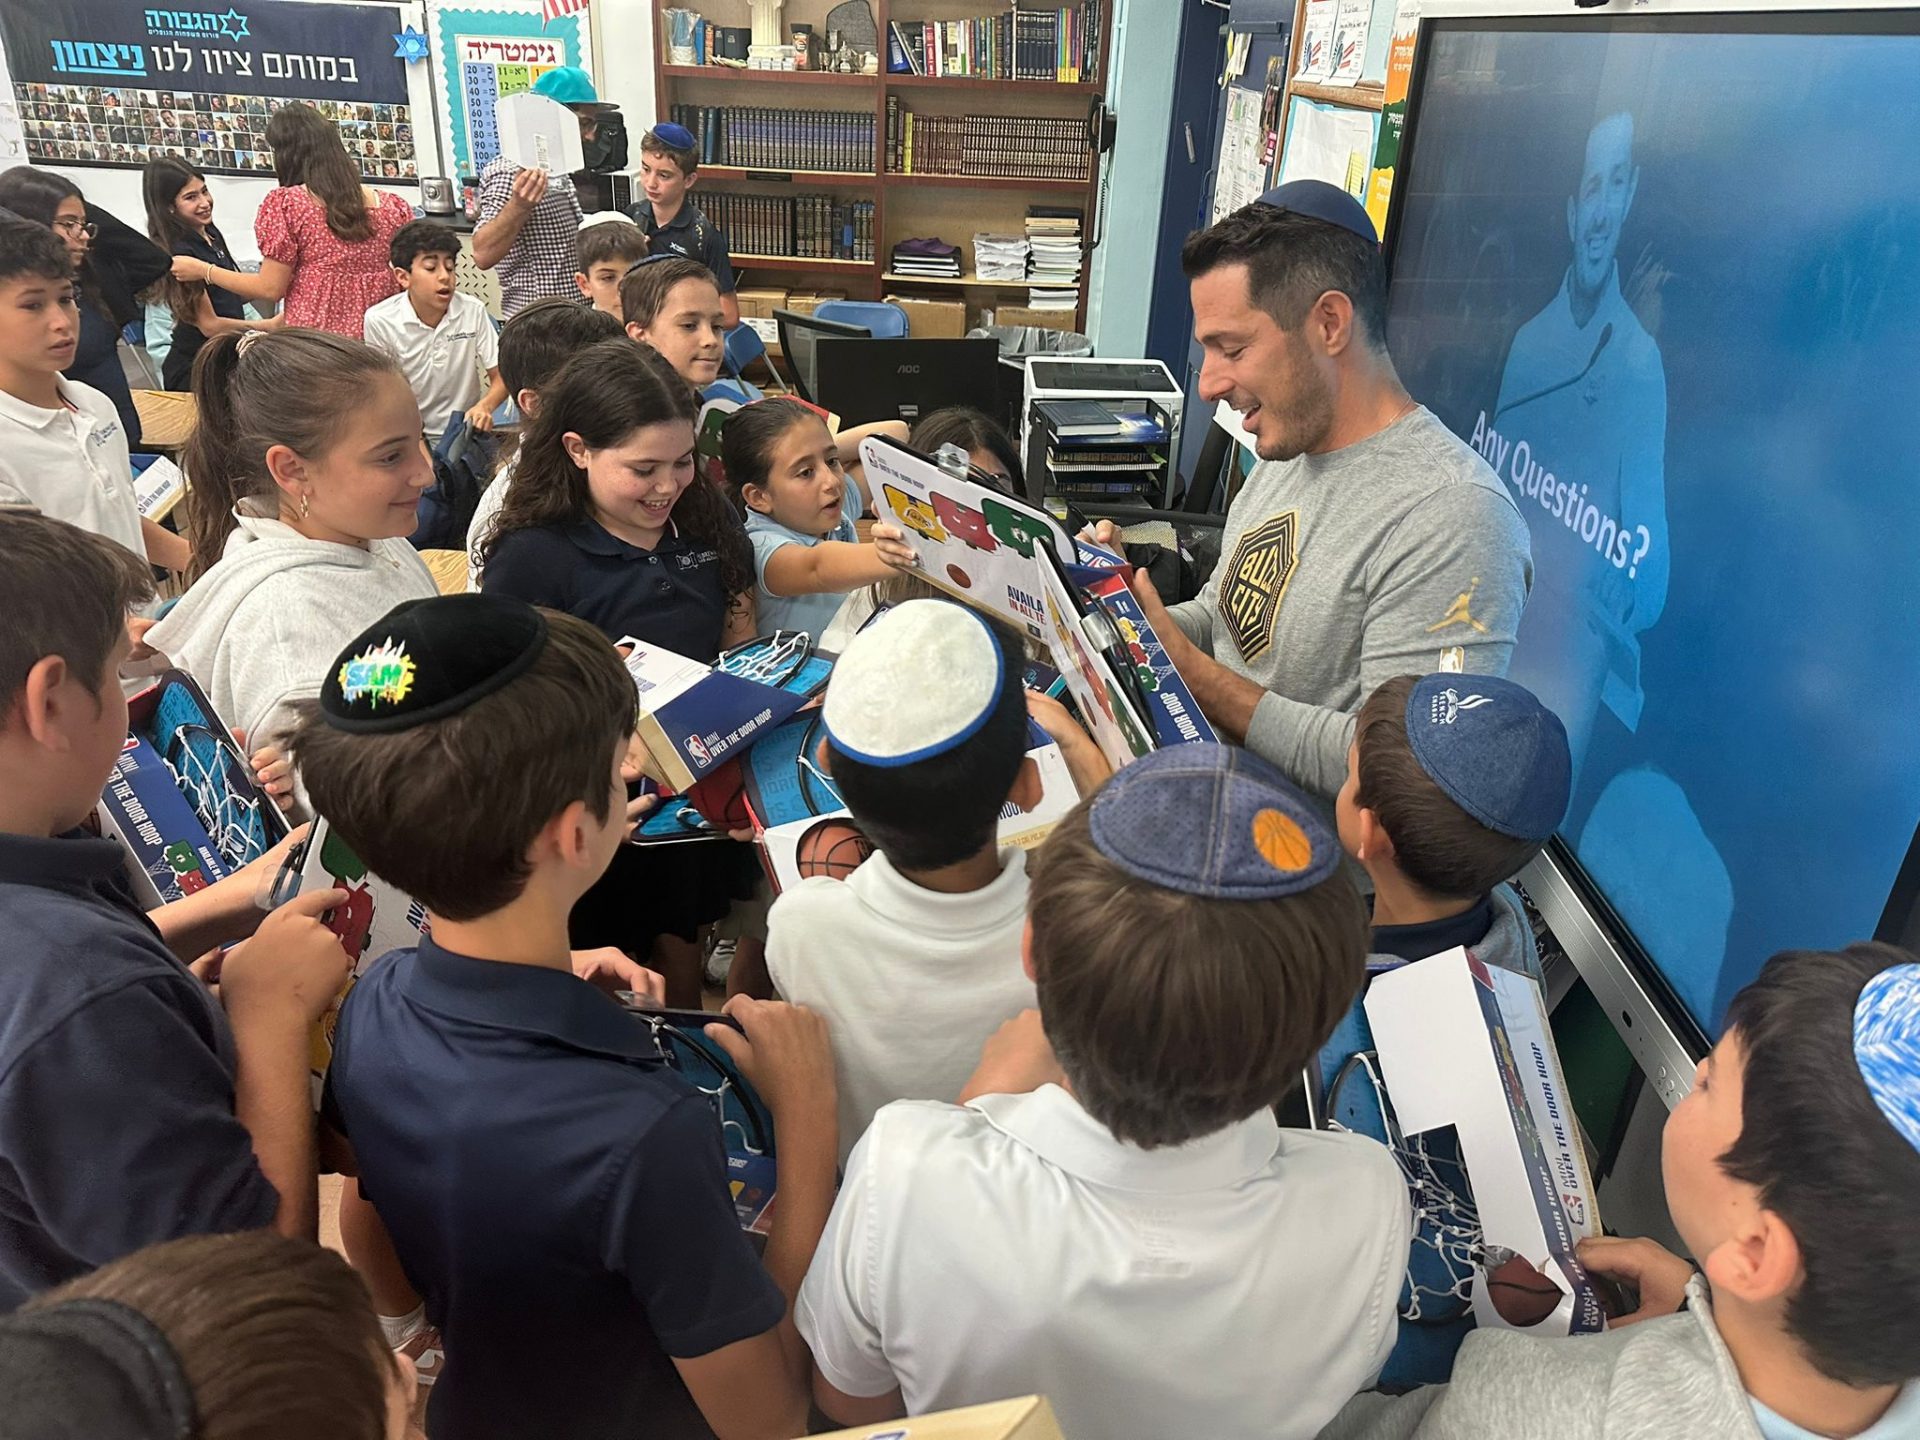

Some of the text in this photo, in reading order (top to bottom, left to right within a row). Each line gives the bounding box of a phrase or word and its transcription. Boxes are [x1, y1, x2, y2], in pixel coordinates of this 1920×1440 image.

[144, 10, 218, 31] הגבורה
[150, 41, 193, 73] לנו
[201, 49, 253, 76] ציוו
[467, 41, 556, 63] גימטריה
[262, 53, 359, 83] במותם
[467, 65, 478, 74] 20
[468, 76, 479, 85] 30
[469, 88, 480, 96] 40
[471, 98, 481, 107] 50
[471, 109, 482, 117] 60
[472, 120, 483, 128] 70
[474, 131, 484, 139] 80
[475, 141, 485, 149] 90
[475, 152, 489, 160] 100
[897, 364, 920, 374] AOC
[1470, 410, 1650, 580] Any Questions?
[1020, 603, 1035, 620] ALL
[1231, 582, 1267, 631] CITY
[346, 663, 403, 688] SAM
[1160, 692, 1200, 741] DOOR HOOP
[703, 731, 721, 748] MINI
[709, 708, 772, 757] OVER THE DOOR HOOP
[111, 779, 135, 801] THE
[121, 796, 149, 825] DOOR
[136, 820, 163, 846] HOOP
[1530, 1041, 1578, 1190] OVER THE DOOR HOOP
[1555, 1156, 1571, 1188] MINI
[1538, 1166, 1557, 1207] HOOP
[1552, 1211, 1570, 1252] DOOR
[1581, 1292, 1592, 1326] MINI
